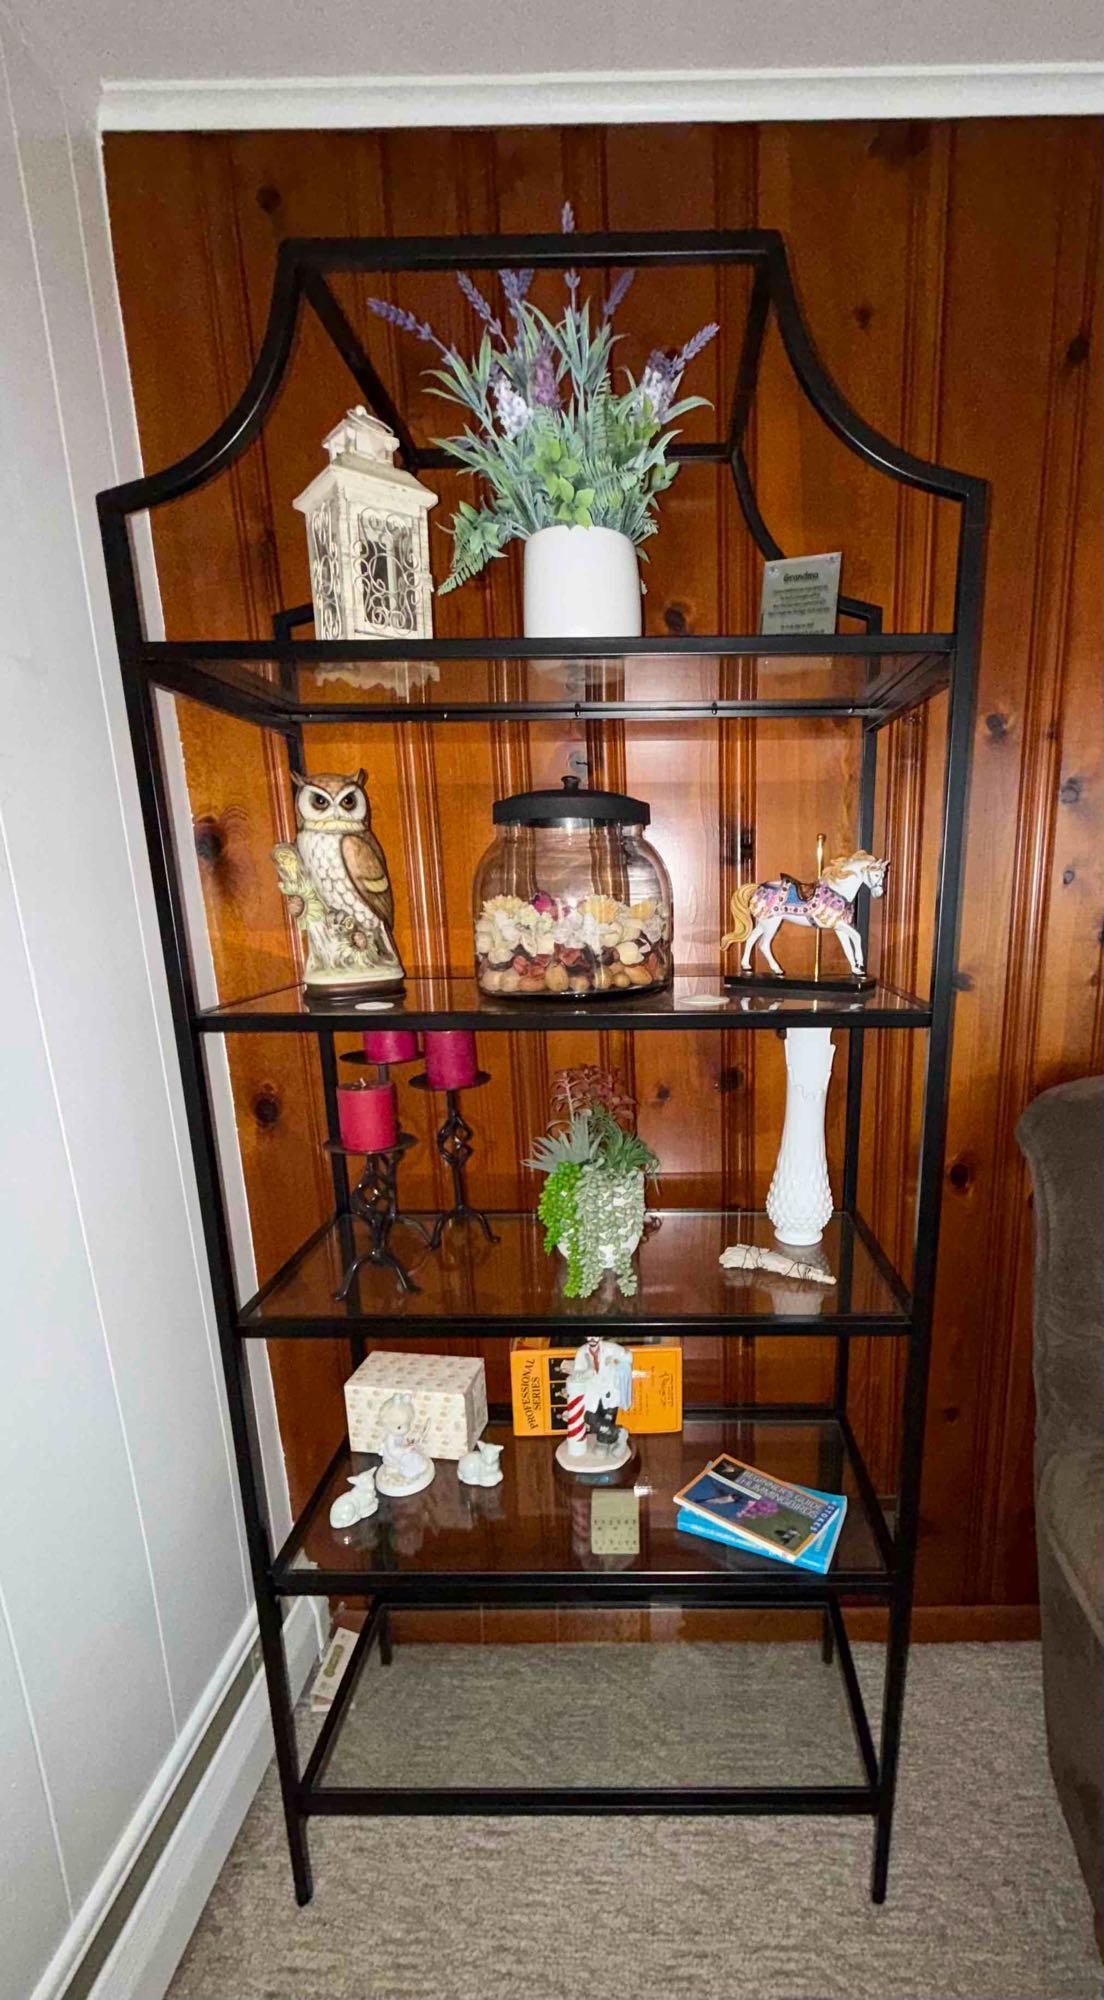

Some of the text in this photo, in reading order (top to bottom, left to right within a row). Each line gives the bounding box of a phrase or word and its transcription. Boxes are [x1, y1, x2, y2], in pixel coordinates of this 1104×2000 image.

[783, 571, 819, 583] Grandma
[521, 1359, 538, 1430] PROFESSIONAL
[531, 1377, 541, 1411] SERIES
[811, 1504, 836, 1532] STOKES
